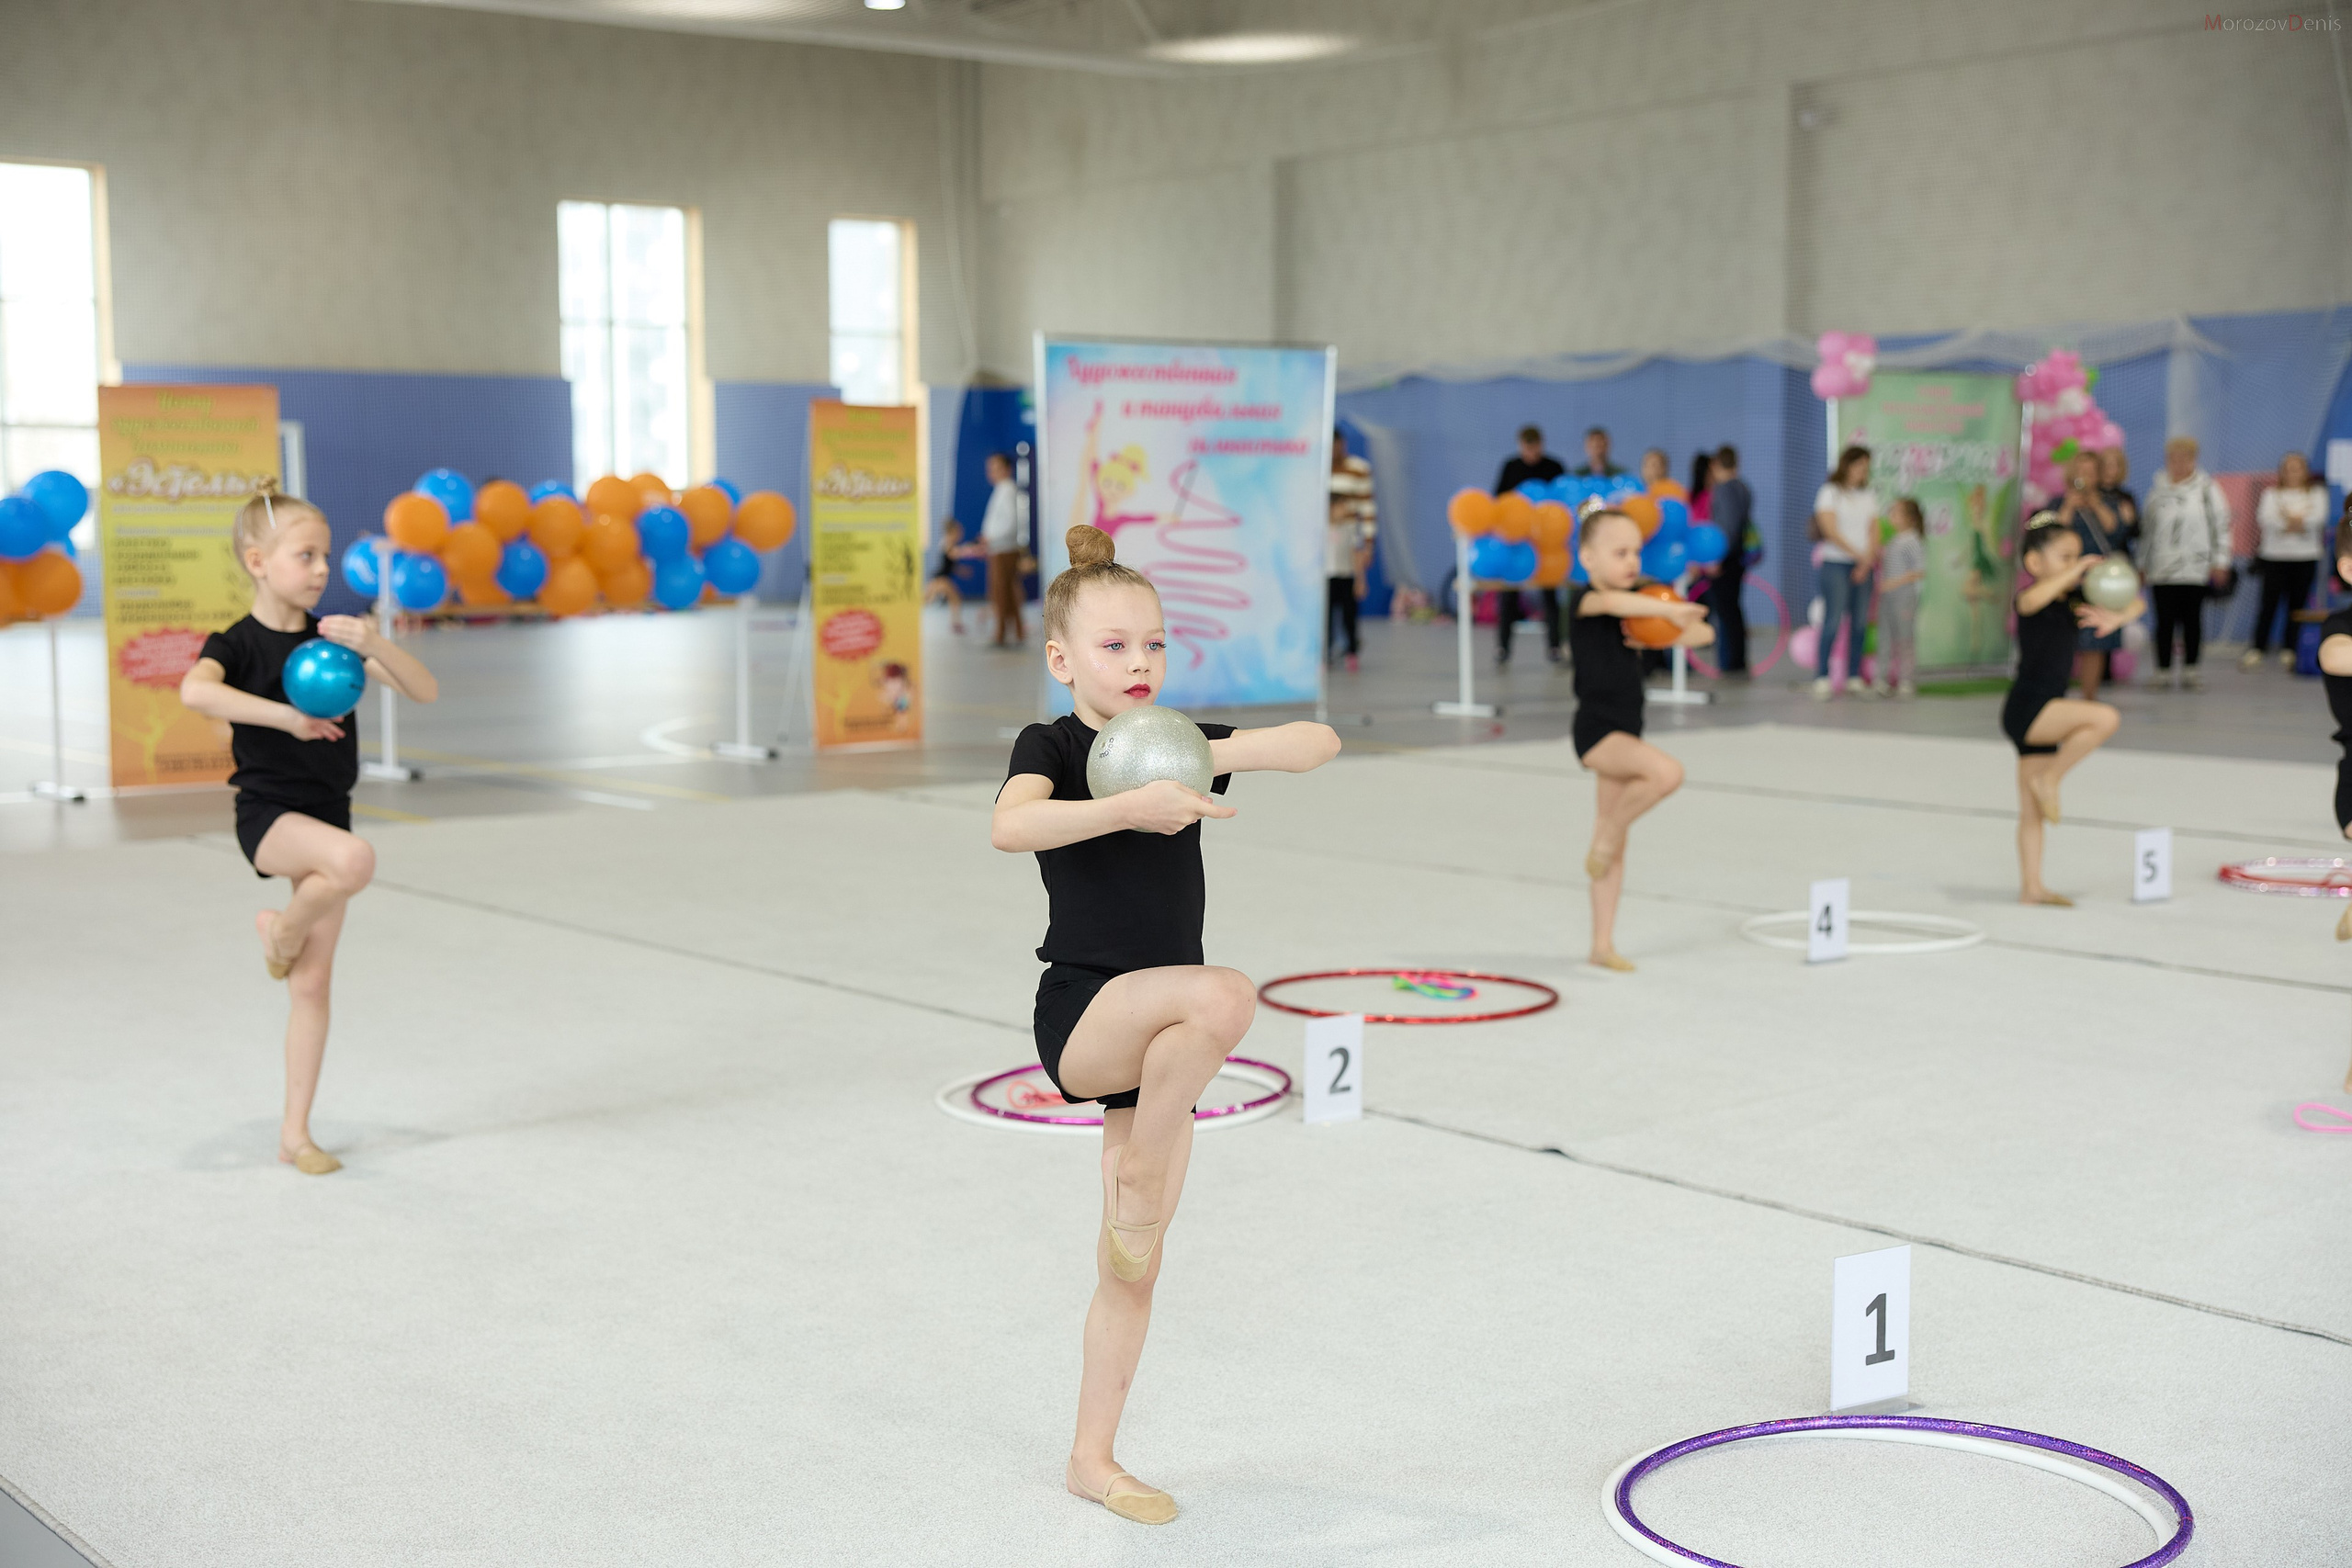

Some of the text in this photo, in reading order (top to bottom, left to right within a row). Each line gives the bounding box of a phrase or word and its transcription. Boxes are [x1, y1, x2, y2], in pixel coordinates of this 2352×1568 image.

[2142, 850, 2157, 883] 5
[1816, 904, 1833, 939] 4
[1329, 1047, 1351, 1094] 2
[1865, 1292, 1894, 1366] 1
